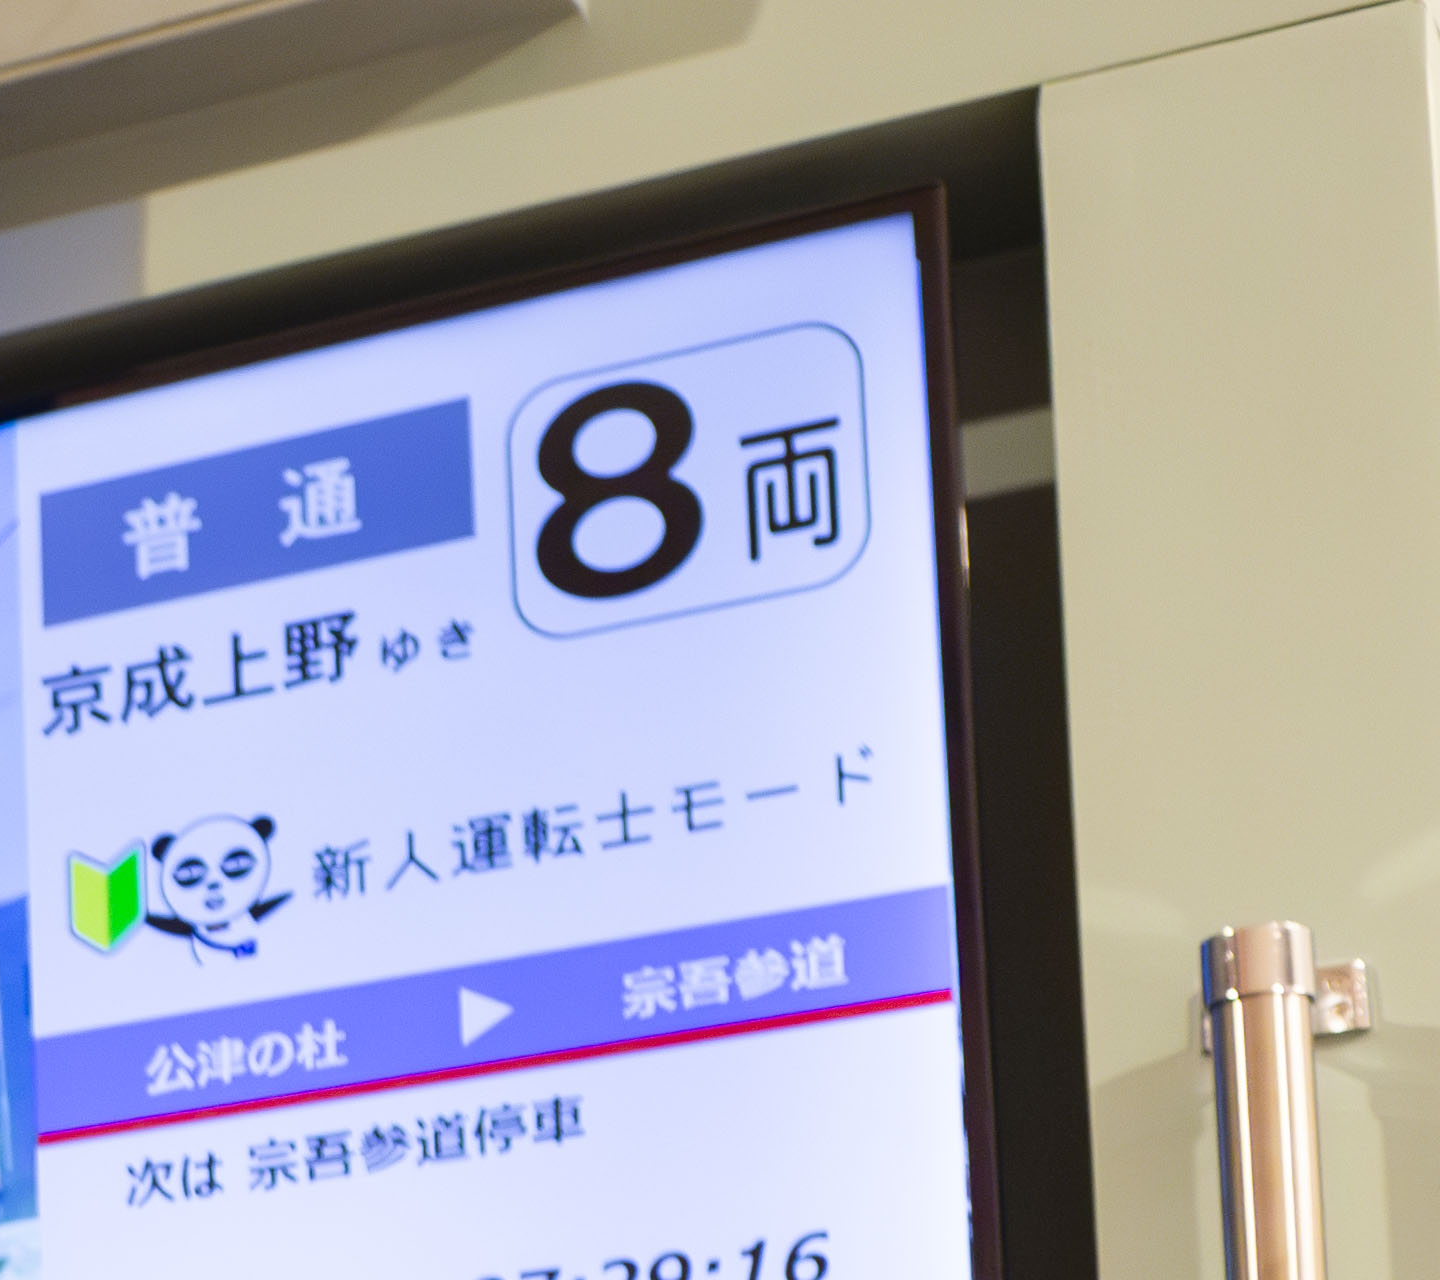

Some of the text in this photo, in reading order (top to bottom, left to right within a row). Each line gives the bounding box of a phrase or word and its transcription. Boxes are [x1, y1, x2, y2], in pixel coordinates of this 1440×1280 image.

[121, 457, 361, 579] 普通
[536, 380, 841, 599] 8両
[313, 745, 872, 901] 新人運転士モード
[622, 933, 849, 1019] 宗吾参道
[145, 1018, 349, 1095] 公津の杜
[126, 1151, 224, 1208] 次は
